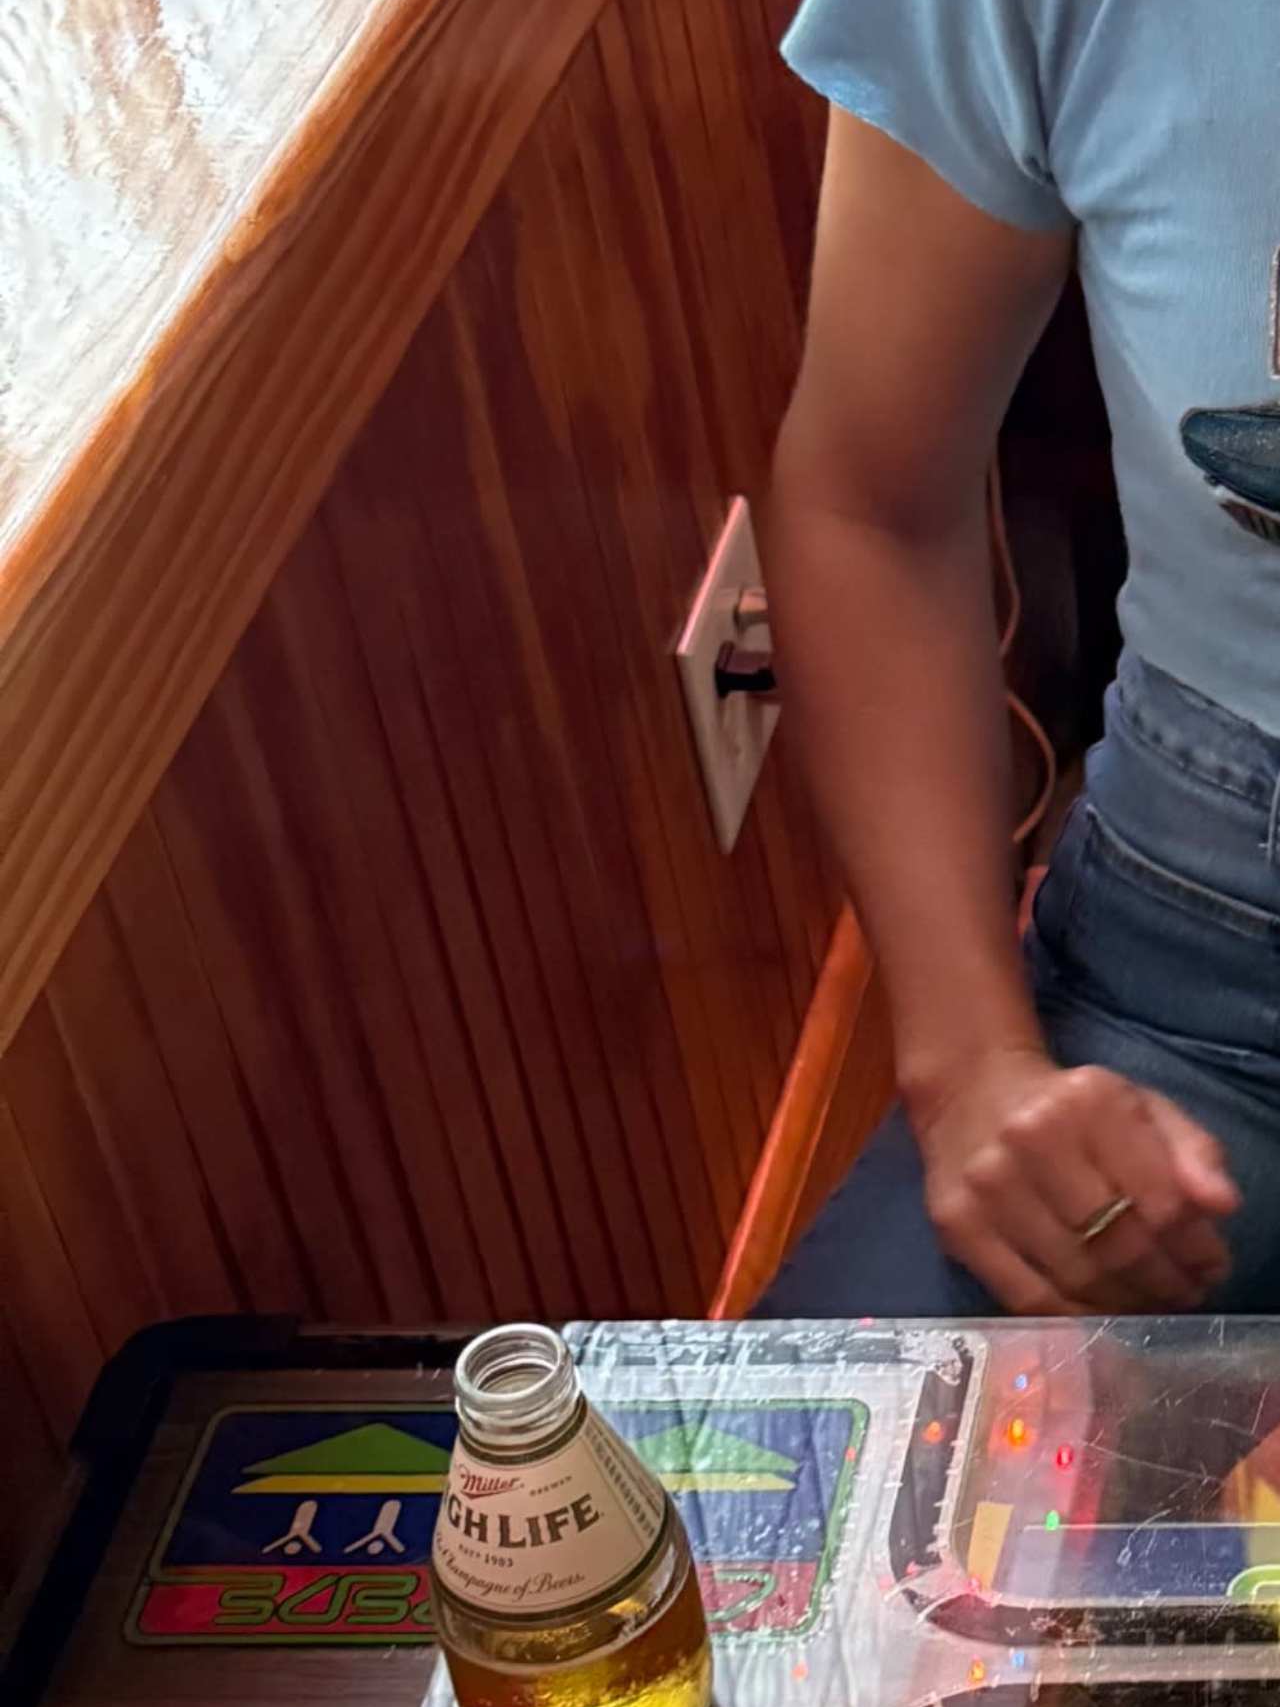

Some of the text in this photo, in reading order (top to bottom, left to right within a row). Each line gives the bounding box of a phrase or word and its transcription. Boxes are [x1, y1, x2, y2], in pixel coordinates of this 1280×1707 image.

[460, 1465, 522, 1500] Miller
[445, 1493, 600, 1548] GH LIFE
